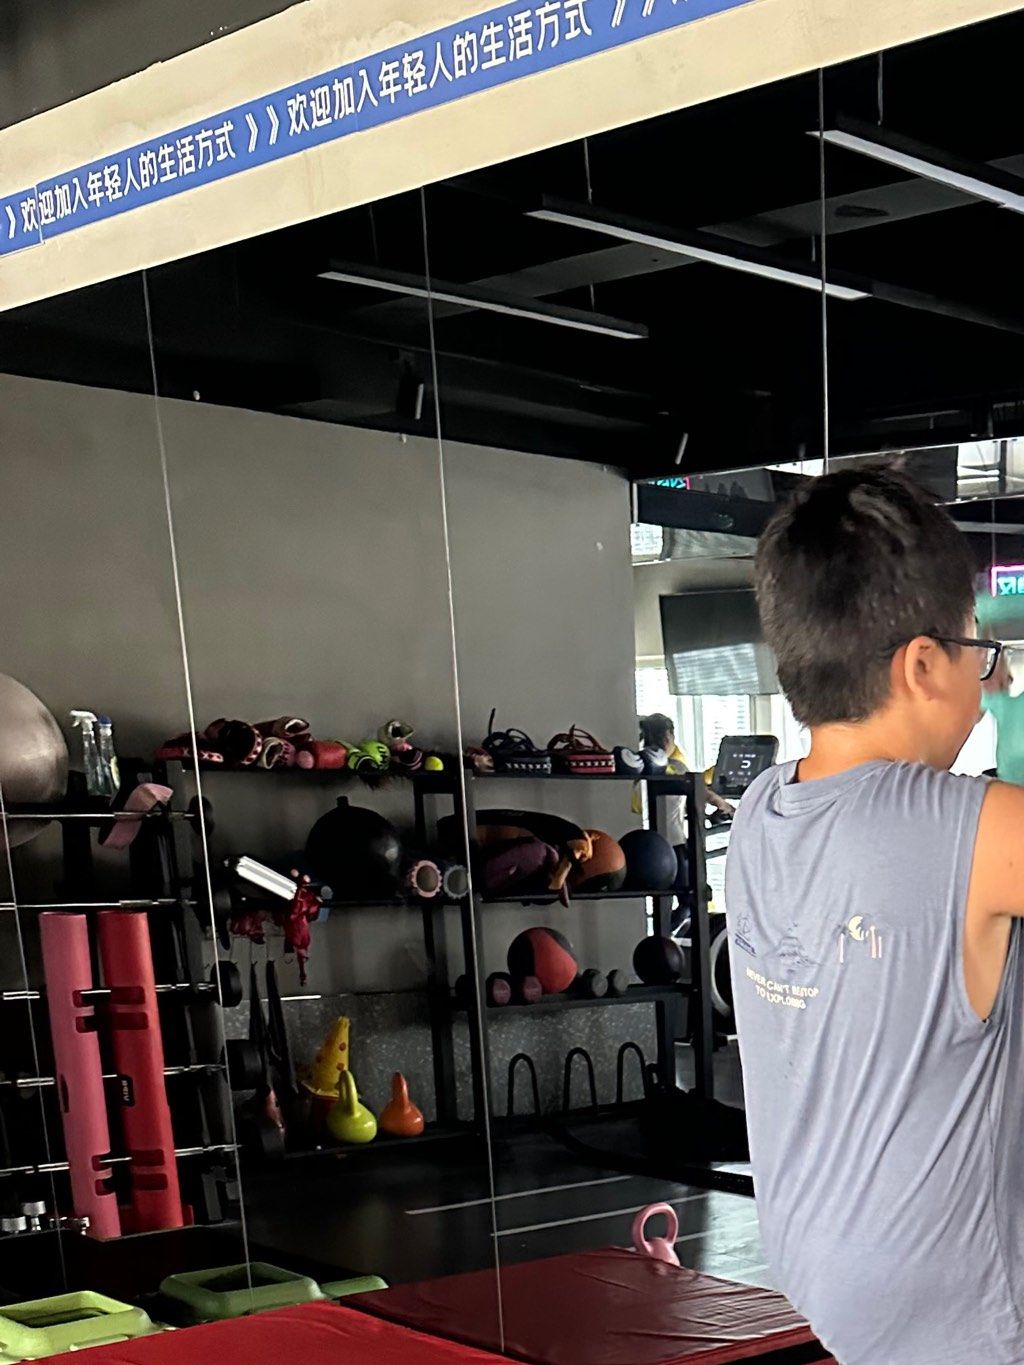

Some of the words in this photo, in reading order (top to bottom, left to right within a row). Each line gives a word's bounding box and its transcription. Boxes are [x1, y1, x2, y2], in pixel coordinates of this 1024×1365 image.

[286, 0, 592, 136] 欢迎加入年轻人的生活方式
[20, 120, 236, 232] 欢迎加入年轻人的生活方式
